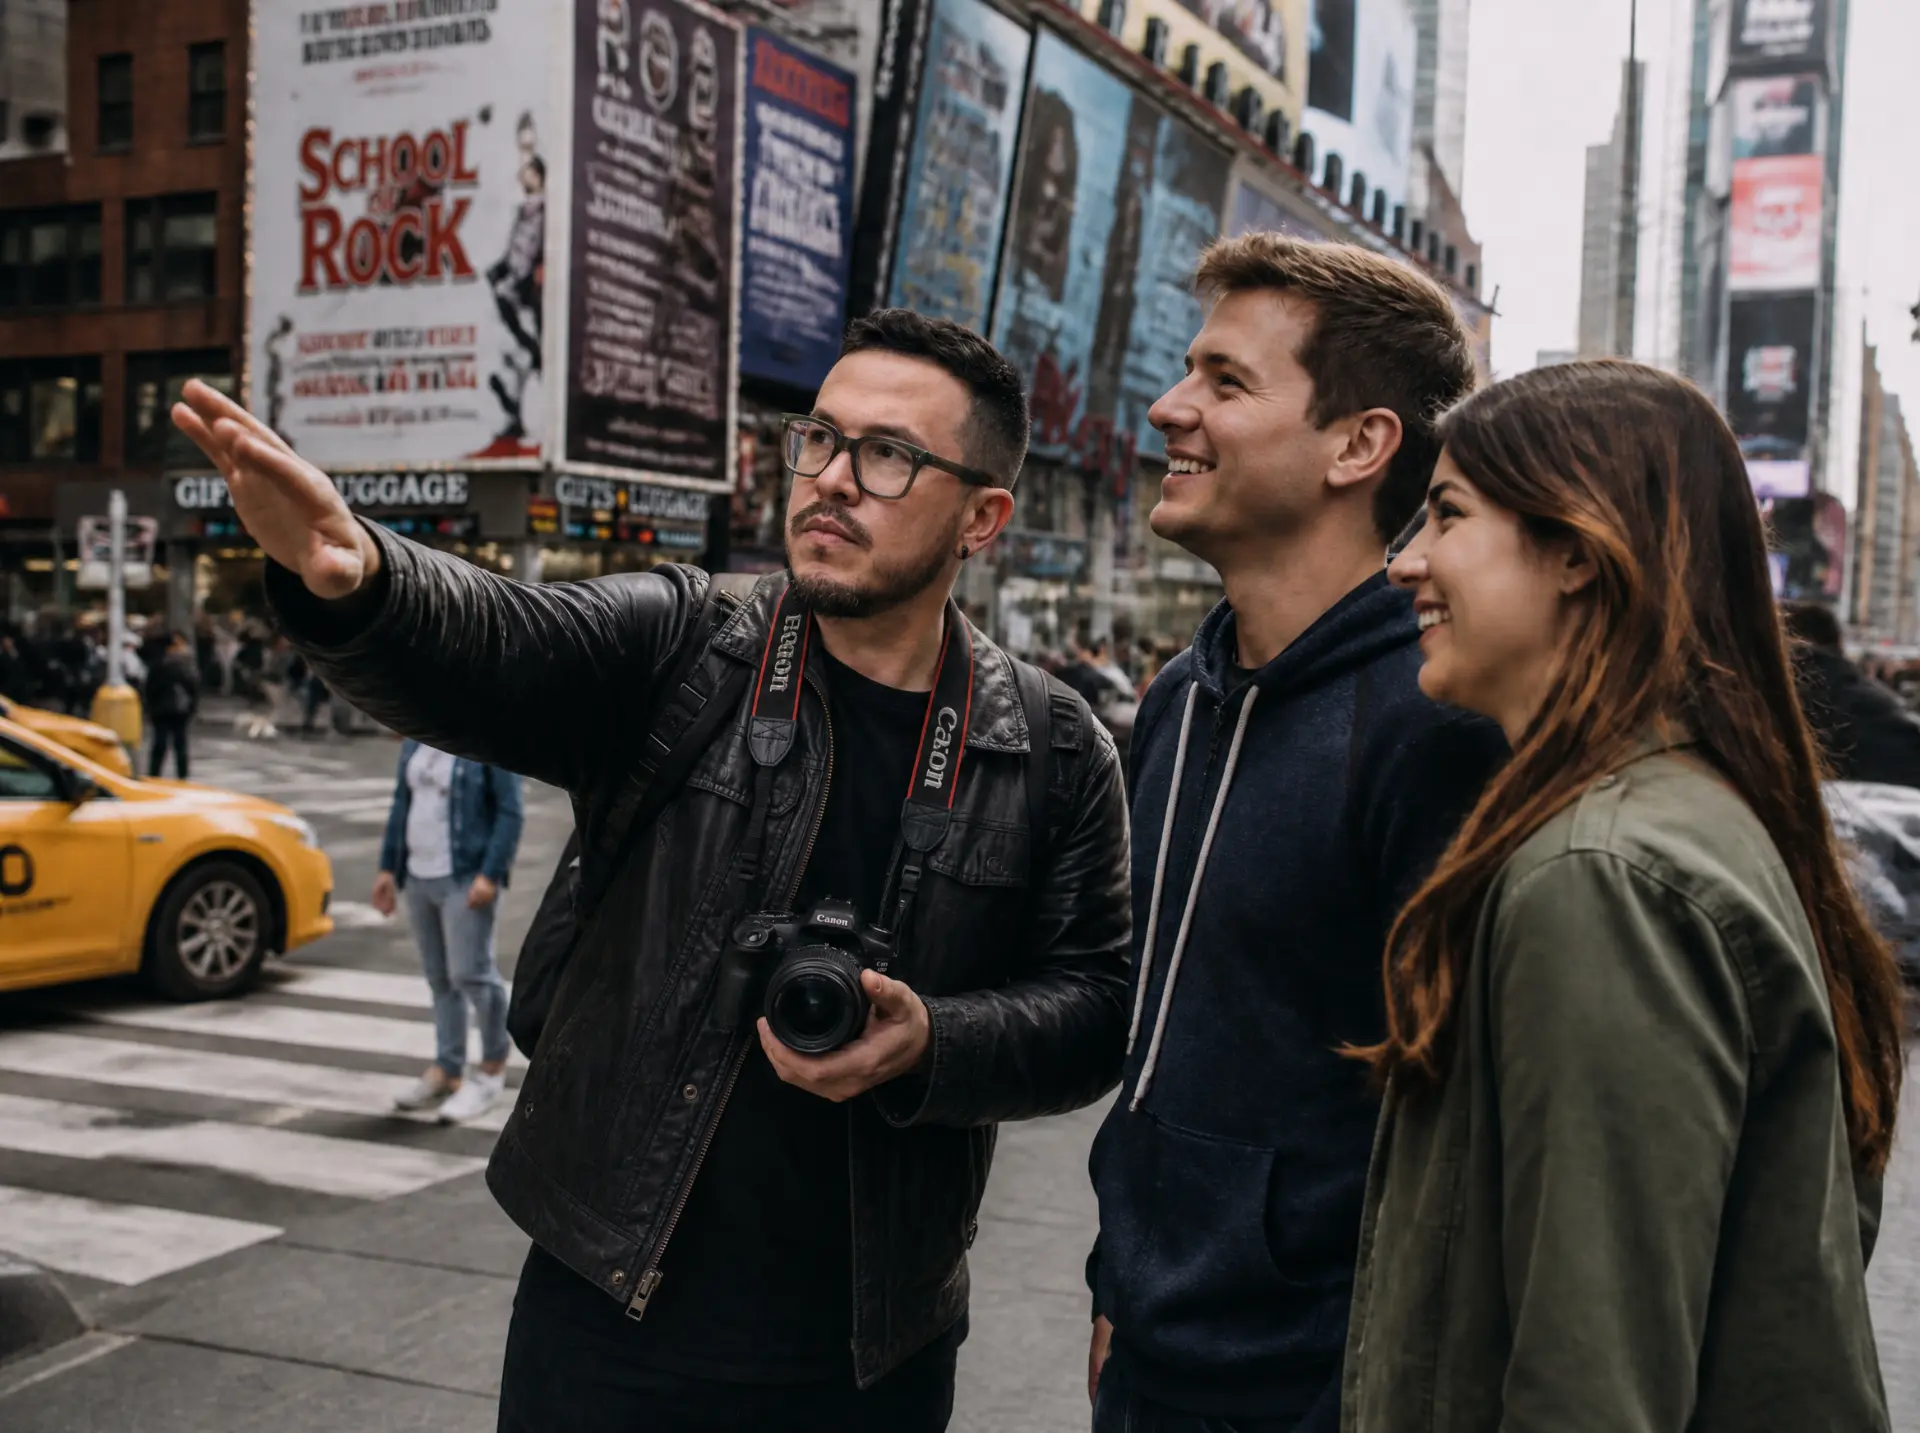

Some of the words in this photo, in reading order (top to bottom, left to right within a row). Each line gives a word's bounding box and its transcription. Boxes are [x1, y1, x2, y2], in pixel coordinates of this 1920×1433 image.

[298, 120, 478, 201] SCHOOL
[298, 197, 478, 293] ROCK
[174, 476, 235, 508] GIF
[335, 473, 468, 506] UGGAGE
[816, 914, 849, 927] Canon
